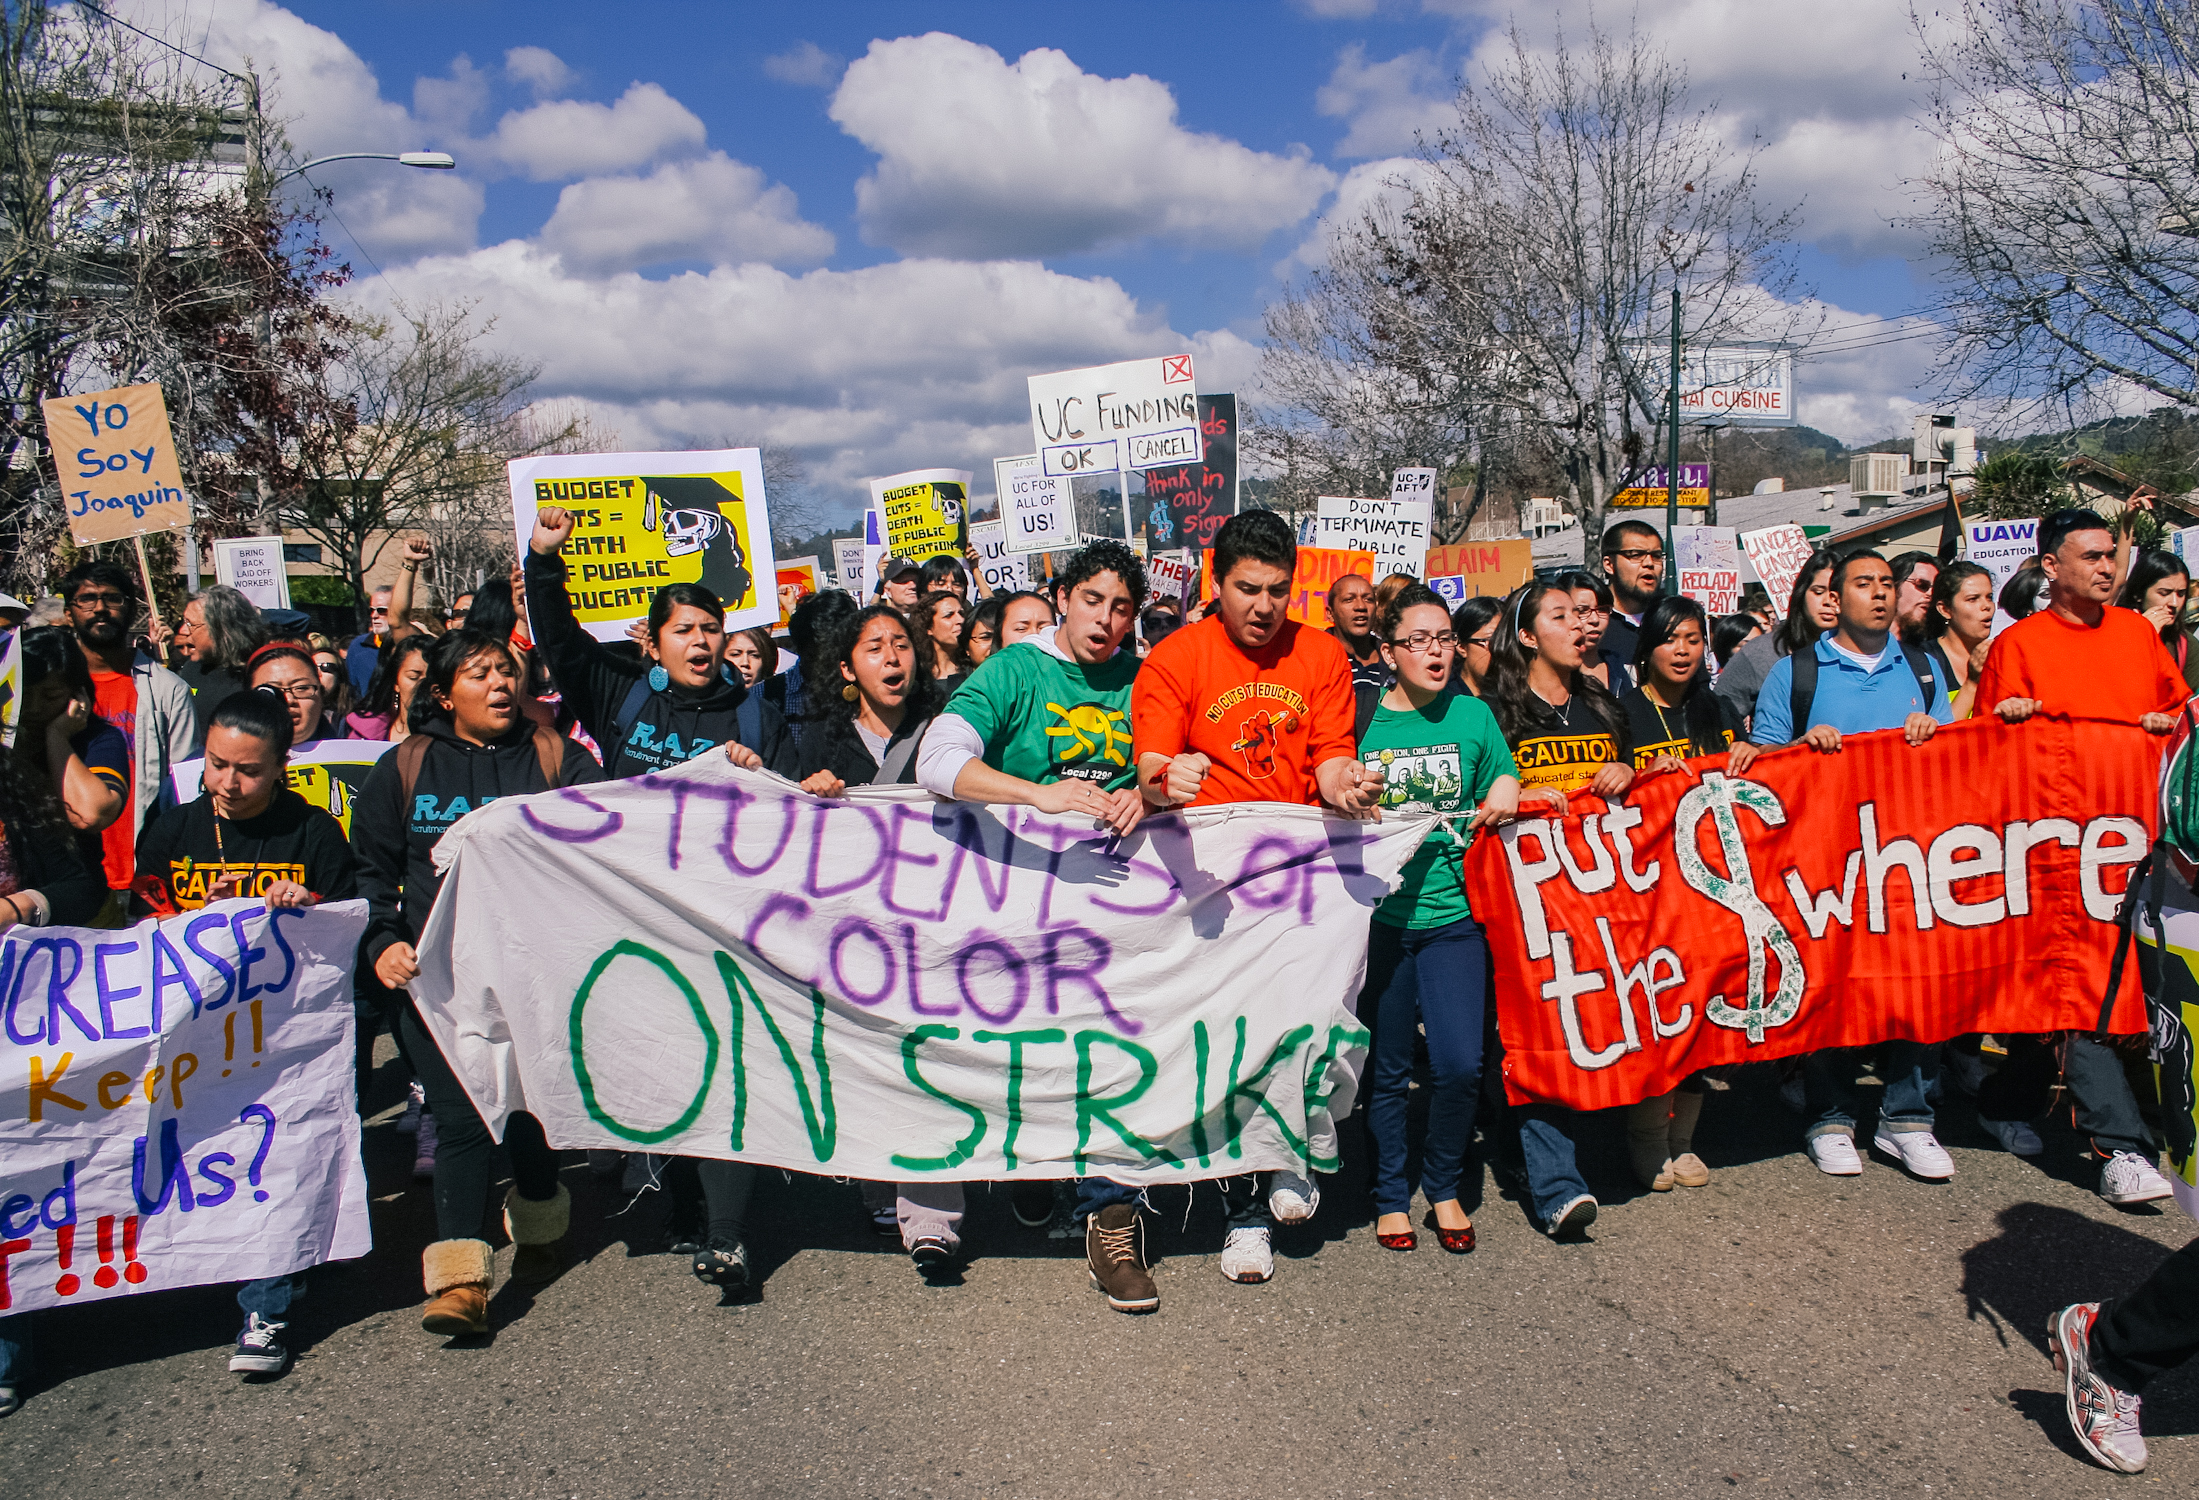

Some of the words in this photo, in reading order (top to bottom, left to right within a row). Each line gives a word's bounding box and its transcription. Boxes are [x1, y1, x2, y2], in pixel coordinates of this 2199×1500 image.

[1680, 390, 1704, 406] HAI
[1712, 389, 1782, 409] CUISINE
[75, 402, 129, 437] YO
[1038, 397, 1085, 442] UC
[1136, 437, 1193, 460] CANCEL
[1013, 459, 1039, 469] AFSC
[1061, 447, 1095, 471] OK
[1012, 482, 1028, 494] UC
[1031, 480, 1056, 492] FOR
[1146, 467, 1191, 496] think
[1202, 466, 1225, 490] in
[1397, 474, 1419, 482] UC-
[535, 479, 635, 501] BUDGET
[883, 484, 927, 502] BUDGET
[1395, 484, 1419, 492] AFT
[1651, 489, 1697, 497] RESTRANT
[71, 481, 184, 519] Joaquin
[885, 502, 911, 517] CUTS
[1016, 497, 1038, 510] ALL
[1040, 494, 1056, 506] OF
[1172, 487, 1214, 514] only
[1350, 500, 1401, 515] DON'T
[574, 509, 602, 528] TS
[887, 515, 924, 531] DEATH
[1023, 513, 1055, 533] US!
[1320, 517, 1424, 538] TERMINATE
[970, 525, 999, 535] FSCME
[1972, 523, 2035, 543] UAW
[561, 536, 627, 556] EATH
[889, 535, 902, 546] OF
[1348, 538, 1407, 556] PUBLIC
[239, 548, 265, 558] BRING
[1426, 546, 1501, 577] CLAIM
[1973, 546, 2036, 560] EDUCATION
[236, 569, 255, 578] LAID
[256, 568, 272, 577] OFF
[241, 559, 265, 568] BACK
[1297, 549, 1373, 585] DING
[1375, 561, 1417, 575] TION
[2000, 564, 2011, 573] IS
[234, 578, 277, 588] WORKERS!
[565, 565, 576, 582] F
[1681, 571, 1738, 591] RECLAIM
[1149, 577, 1172, 591] MAKE
[1708, 591, 1738, 614] BAY!
[1205, 704, 1224, 724] NO
[1218, 686, 1247, 709] CUTS
[1257, 683, 1309, 718] EDUCATION
[1364, 751, 1380, 761] ONE
[1393, 748, 1411, 758] ION.
[1412, 746, 1429, 756] ONE
[1431, 743, 1459, 754] FIGHT.
[1517, 740, 1618, 768] CAUTION
[1061, 765, 1090, 779] Local
[411, 823, 448, 833] Recruitmen
[518, 774, 1190, 928] STUDENTS
[1234, 833, 1381, 926] OF
[1785, 803, 2151, 939] where
[744, 893, 1143, 1036] COLOR
[1541, 916, 1693, 1072] the
[569, 938, 834, 1163] ON
[890, 1014, 1371, 1176] STRIKE
[0, 1160, 77, 1239] ed
[132, 1103, 277, 1216] Us?
